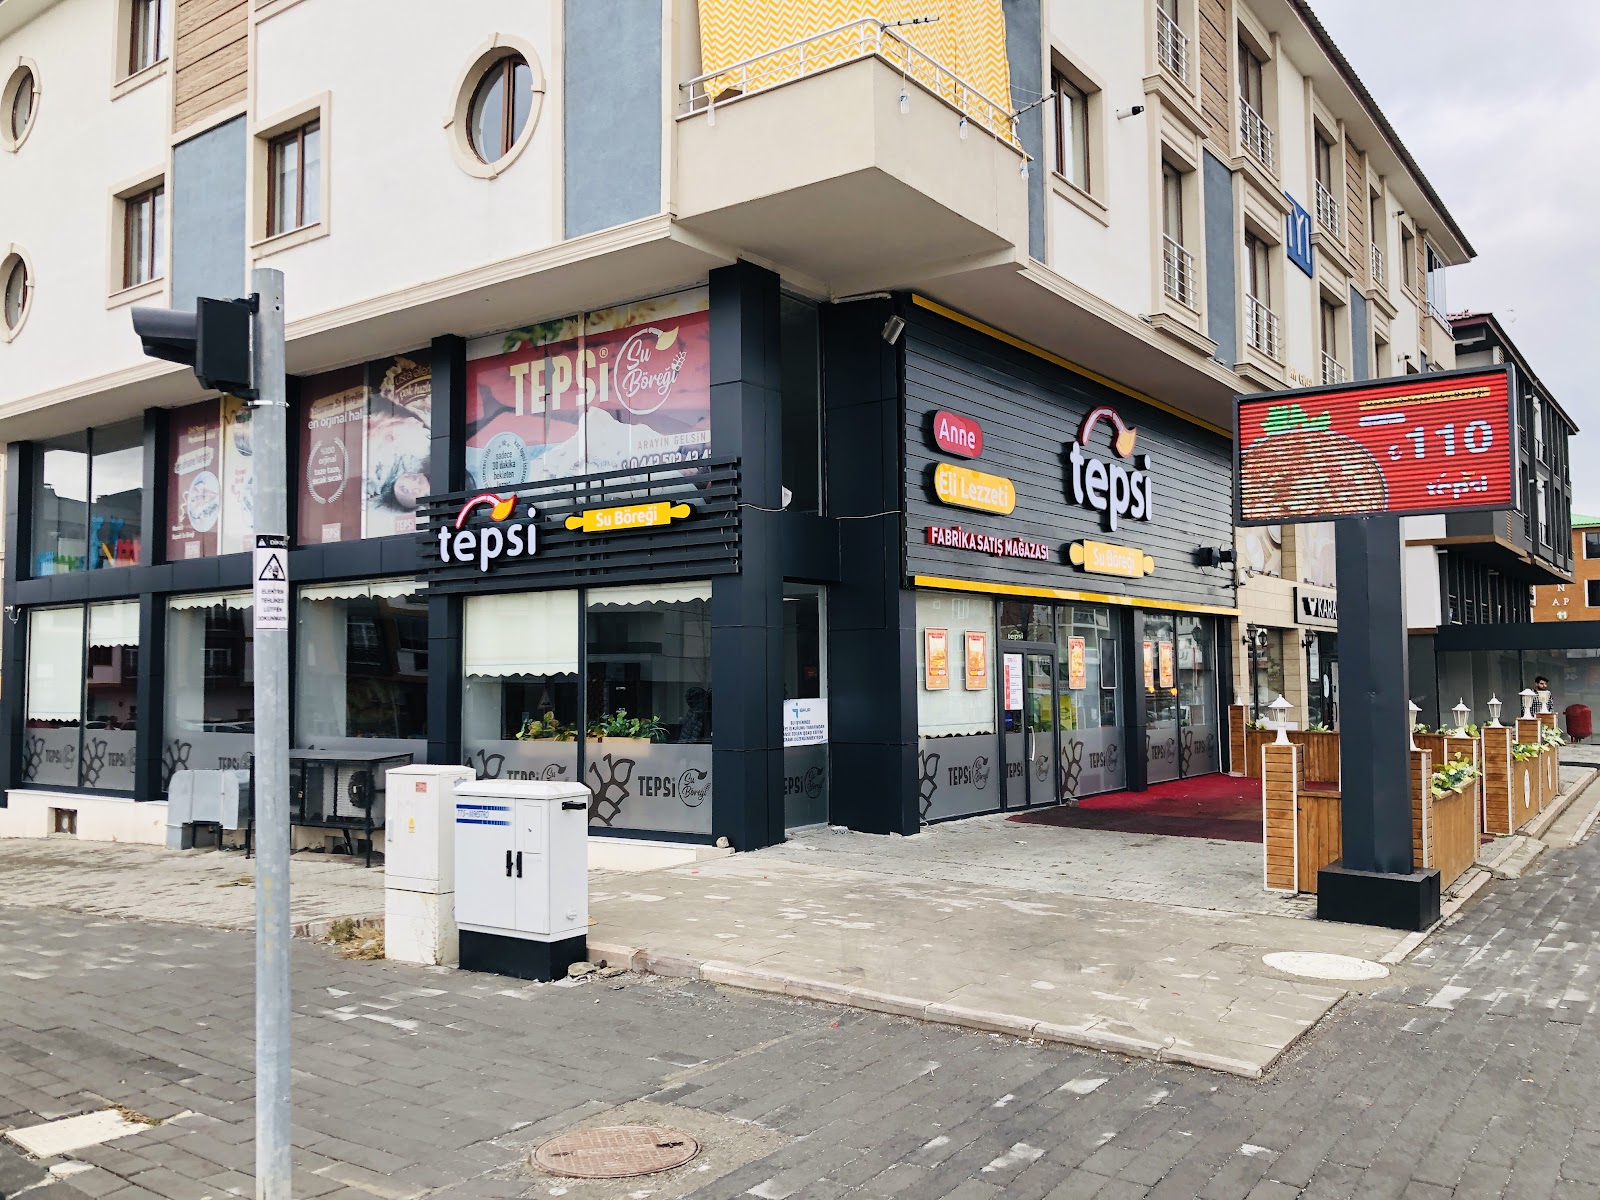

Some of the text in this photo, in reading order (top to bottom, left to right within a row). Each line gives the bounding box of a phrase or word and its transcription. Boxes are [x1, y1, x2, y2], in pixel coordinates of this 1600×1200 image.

[626, 339, 652, 370] Su
[637, 437, 670, 450] ARAYIN
[939, 418, 976, 449] Anne
[496, 451, 513, 460] sadece
[939, 471, 1009, 507] Eli Lezzeti
[1069, 440, 1153, 532] tepsi
[595, 506, 658, 528] Su Böreği
[438, 506, 537, 573] tepsi
[931, 526, 1049, 560] FABRİKA SATIŞ MAĞAZASI
[1093, 547, 1105, 567] Su
[1008, 632, 1024, 641] tepsi
